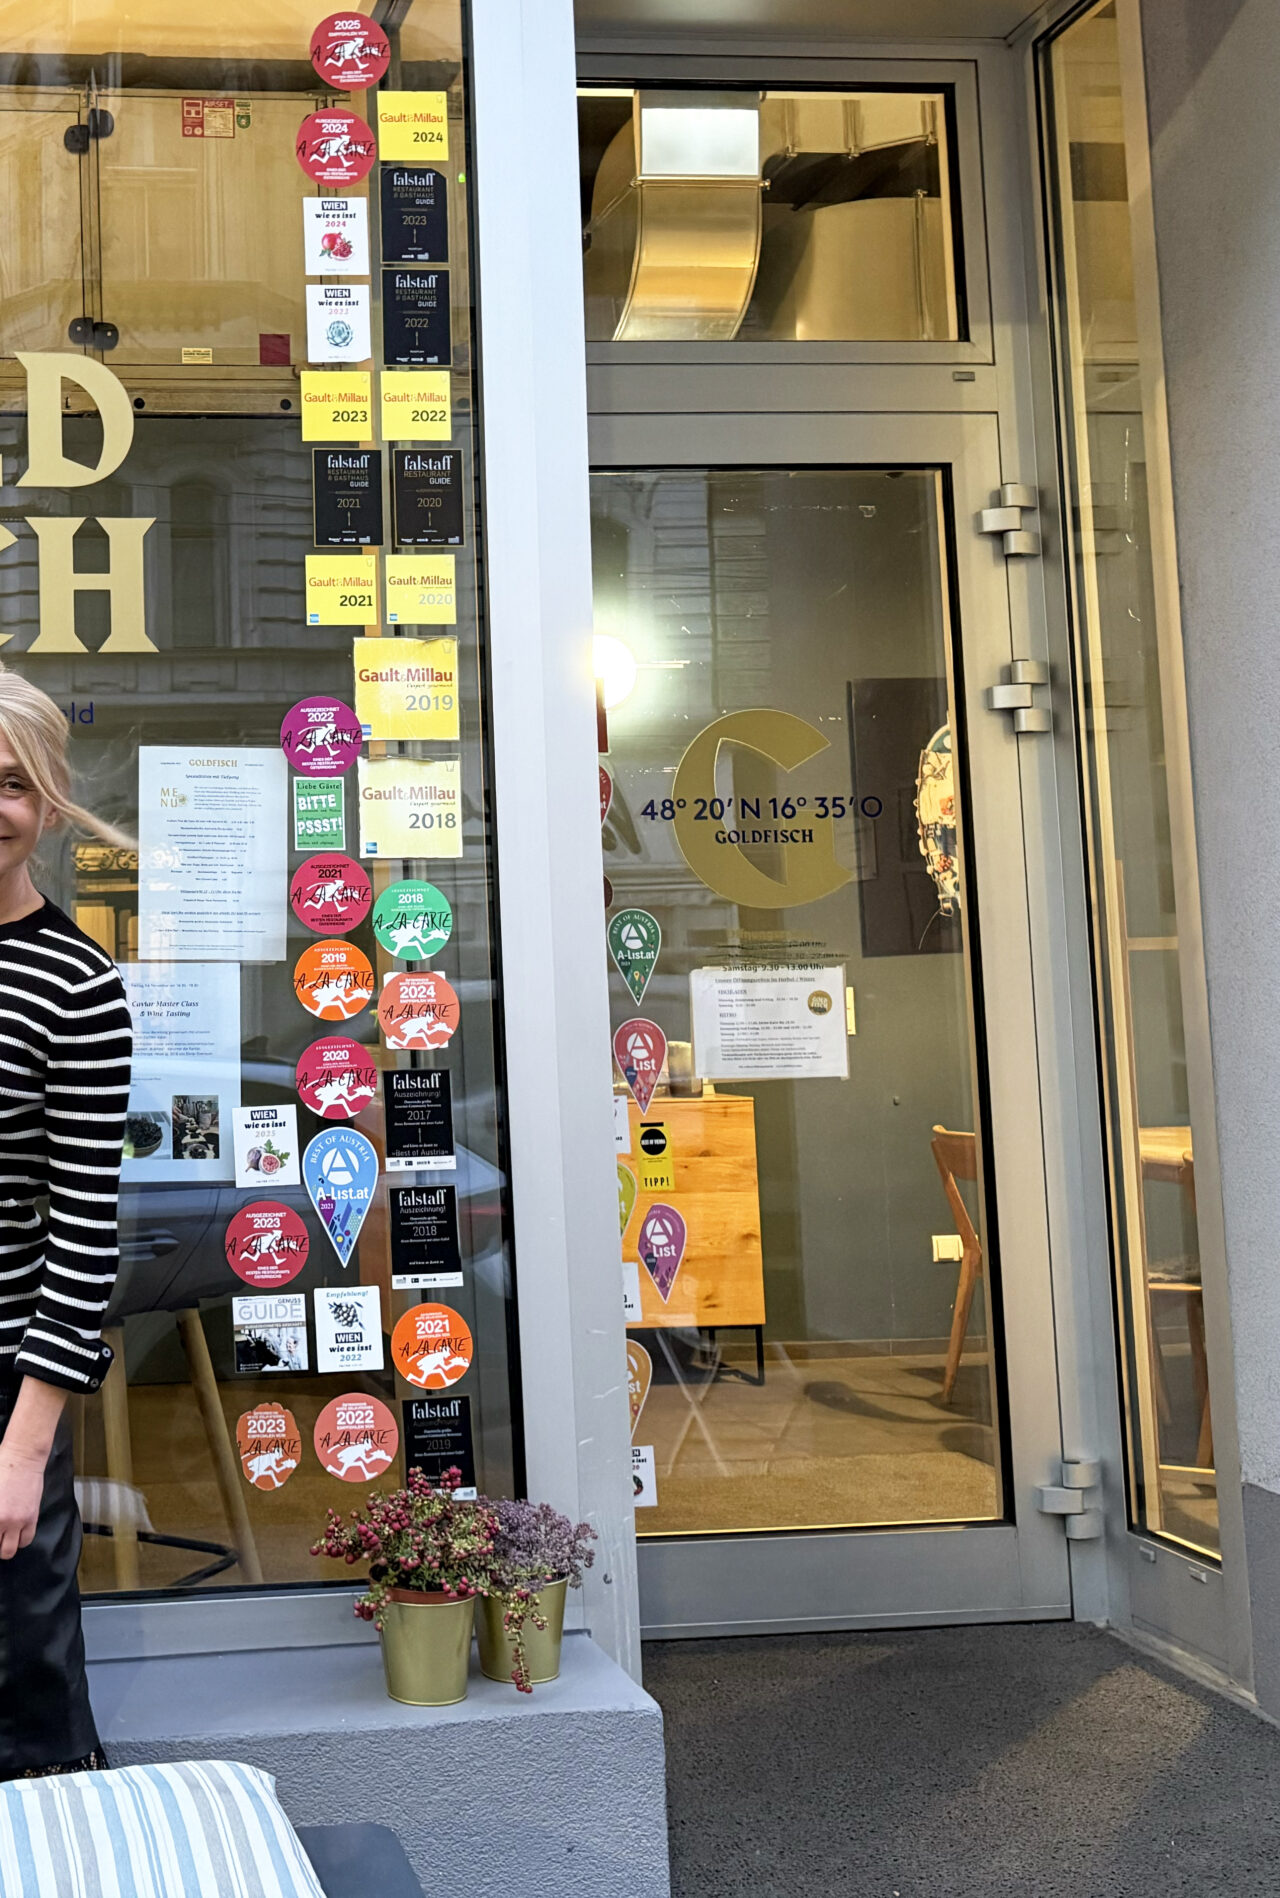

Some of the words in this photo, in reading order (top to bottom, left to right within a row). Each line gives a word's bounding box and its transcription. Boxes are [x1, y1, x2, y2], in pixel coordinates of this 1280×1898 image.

[334, 20, 361, 30] 2025
[321, 123, 348, 133] 2024
[413, 131, 443, 143] 2024
[296, 140, 307, 158] A
[393, 172, 436, 186] falstaff
[322, 202, 346, 210] WIEN
[402, 215, 427, 225] 2023
[395, 274, 439, 288] falstaff
[326, 289, 349, 298] WIEN
[404, 318, 429, 328] 2022
[332, 410, 368, 422] 2023
[411, 410, 447, 422] 2022
[328, 454, 370, 468] falstaff
[404, 455, 453, 471] falstaff
[429, 477, 451, 485] GUIDE
[337, 498, 361, 508] 2021
[417, 498, 442, 507] 2020
[339, 595, 373, 607] 2021
[418, 593, 453, 605] 2020
[405, 695, 453, 711] 2019
[307, 712, 335, 722] 2022
[281, 730, 292, 749] A
[188, 759, 238, 768] GOLDFISCH
[318, 782, 342, 790] Gäste!
[297, 794, 336, 811] BITTE
[640, 797, 687, 821] 48°
[740, 798, 761, 819] N
[770, 796, 808, 819] 16°
[860, 796, 883, 818] O
[297, 817, 343, 835] PSSST!
[408, 813, 457, 829] 2018
[715, 828, 814, 844] GOLDFISCH
[318, 869, 342, 878] 2021
[291, 886, 303, 905] A
[331, 885, 371, 905] CARTE
[398, 893, 424, 904] 2018
[372, 914, 385, 930] A
[386, 912, 409, 930] LA
[413, 911, 452, 930] CARTE
[321, 953, 347, 963] 2019
[294, 972, 306, 990] A
[308, 971, 331, 989] LA
[335, 970, 374, 989] CARTE
[399, 985, 436, 999] 2024
[382, 1004, 394, 1020] A
[396, 1003, 414, 1019] LA
[417, 1003, 456, 1020] CARTE
[322, 1050, 350, 1061] 2020
[633, 1058, 656, 1071] List
[296, 1072, 309, 1090] A
[311, 1069, 333, 1088] LA
[338, 1068, 377, 1087] CARTE
[393, 1073, 441, 1090] falstaff
[393, 1090, 441, 1098] Auszeichnung!
[252, 1110, 276, 1120] WIEN
[406, 1110, 431, 1120] 2017
[310, 1141, 325, 1164] BEST
[325, 1135, 337, 1145] OF
[340, 1135, 370, 1163] AUSTRIA
[644, 1176, 670, 1188] TIPP!
[316, 1186, 369, 1201] A-List.at
[399, 1188, 447, 1206] falstaff
[400, 1205, 446, 1214] Auszeichnung!
[253, 1218, 280, 1228] 2023
[413, 1226, 437, 1237] 2018
[226, 1237, 237, 1256] A
[652, 1244, 677, 1257] List
[238, 1304, 302, 1320] GUIDE
[415, 1319, 450, 1334] 2021
[336, 1332, 361, 1342] WIEN
[399, 1341, 410, 1357] A
[413, 1340, 430, 1355] LA
[434, 1337, 471, 1355] CARTE
[412, 1400, 461, 1419] falstaff
[336, 1410, 374, 1425] 2022
[247, 1419, 286, 1434] 2023
[320, 1432, 331, 1448] A
[333, 1430, 351, 1446] LA
[354, 1429, 395, 1447] CARTE
[426, 1439, 451, 1450] 2019
[243, 1439, 261, 1455] LA
[265, 1439, 301, 1456] CARTE
